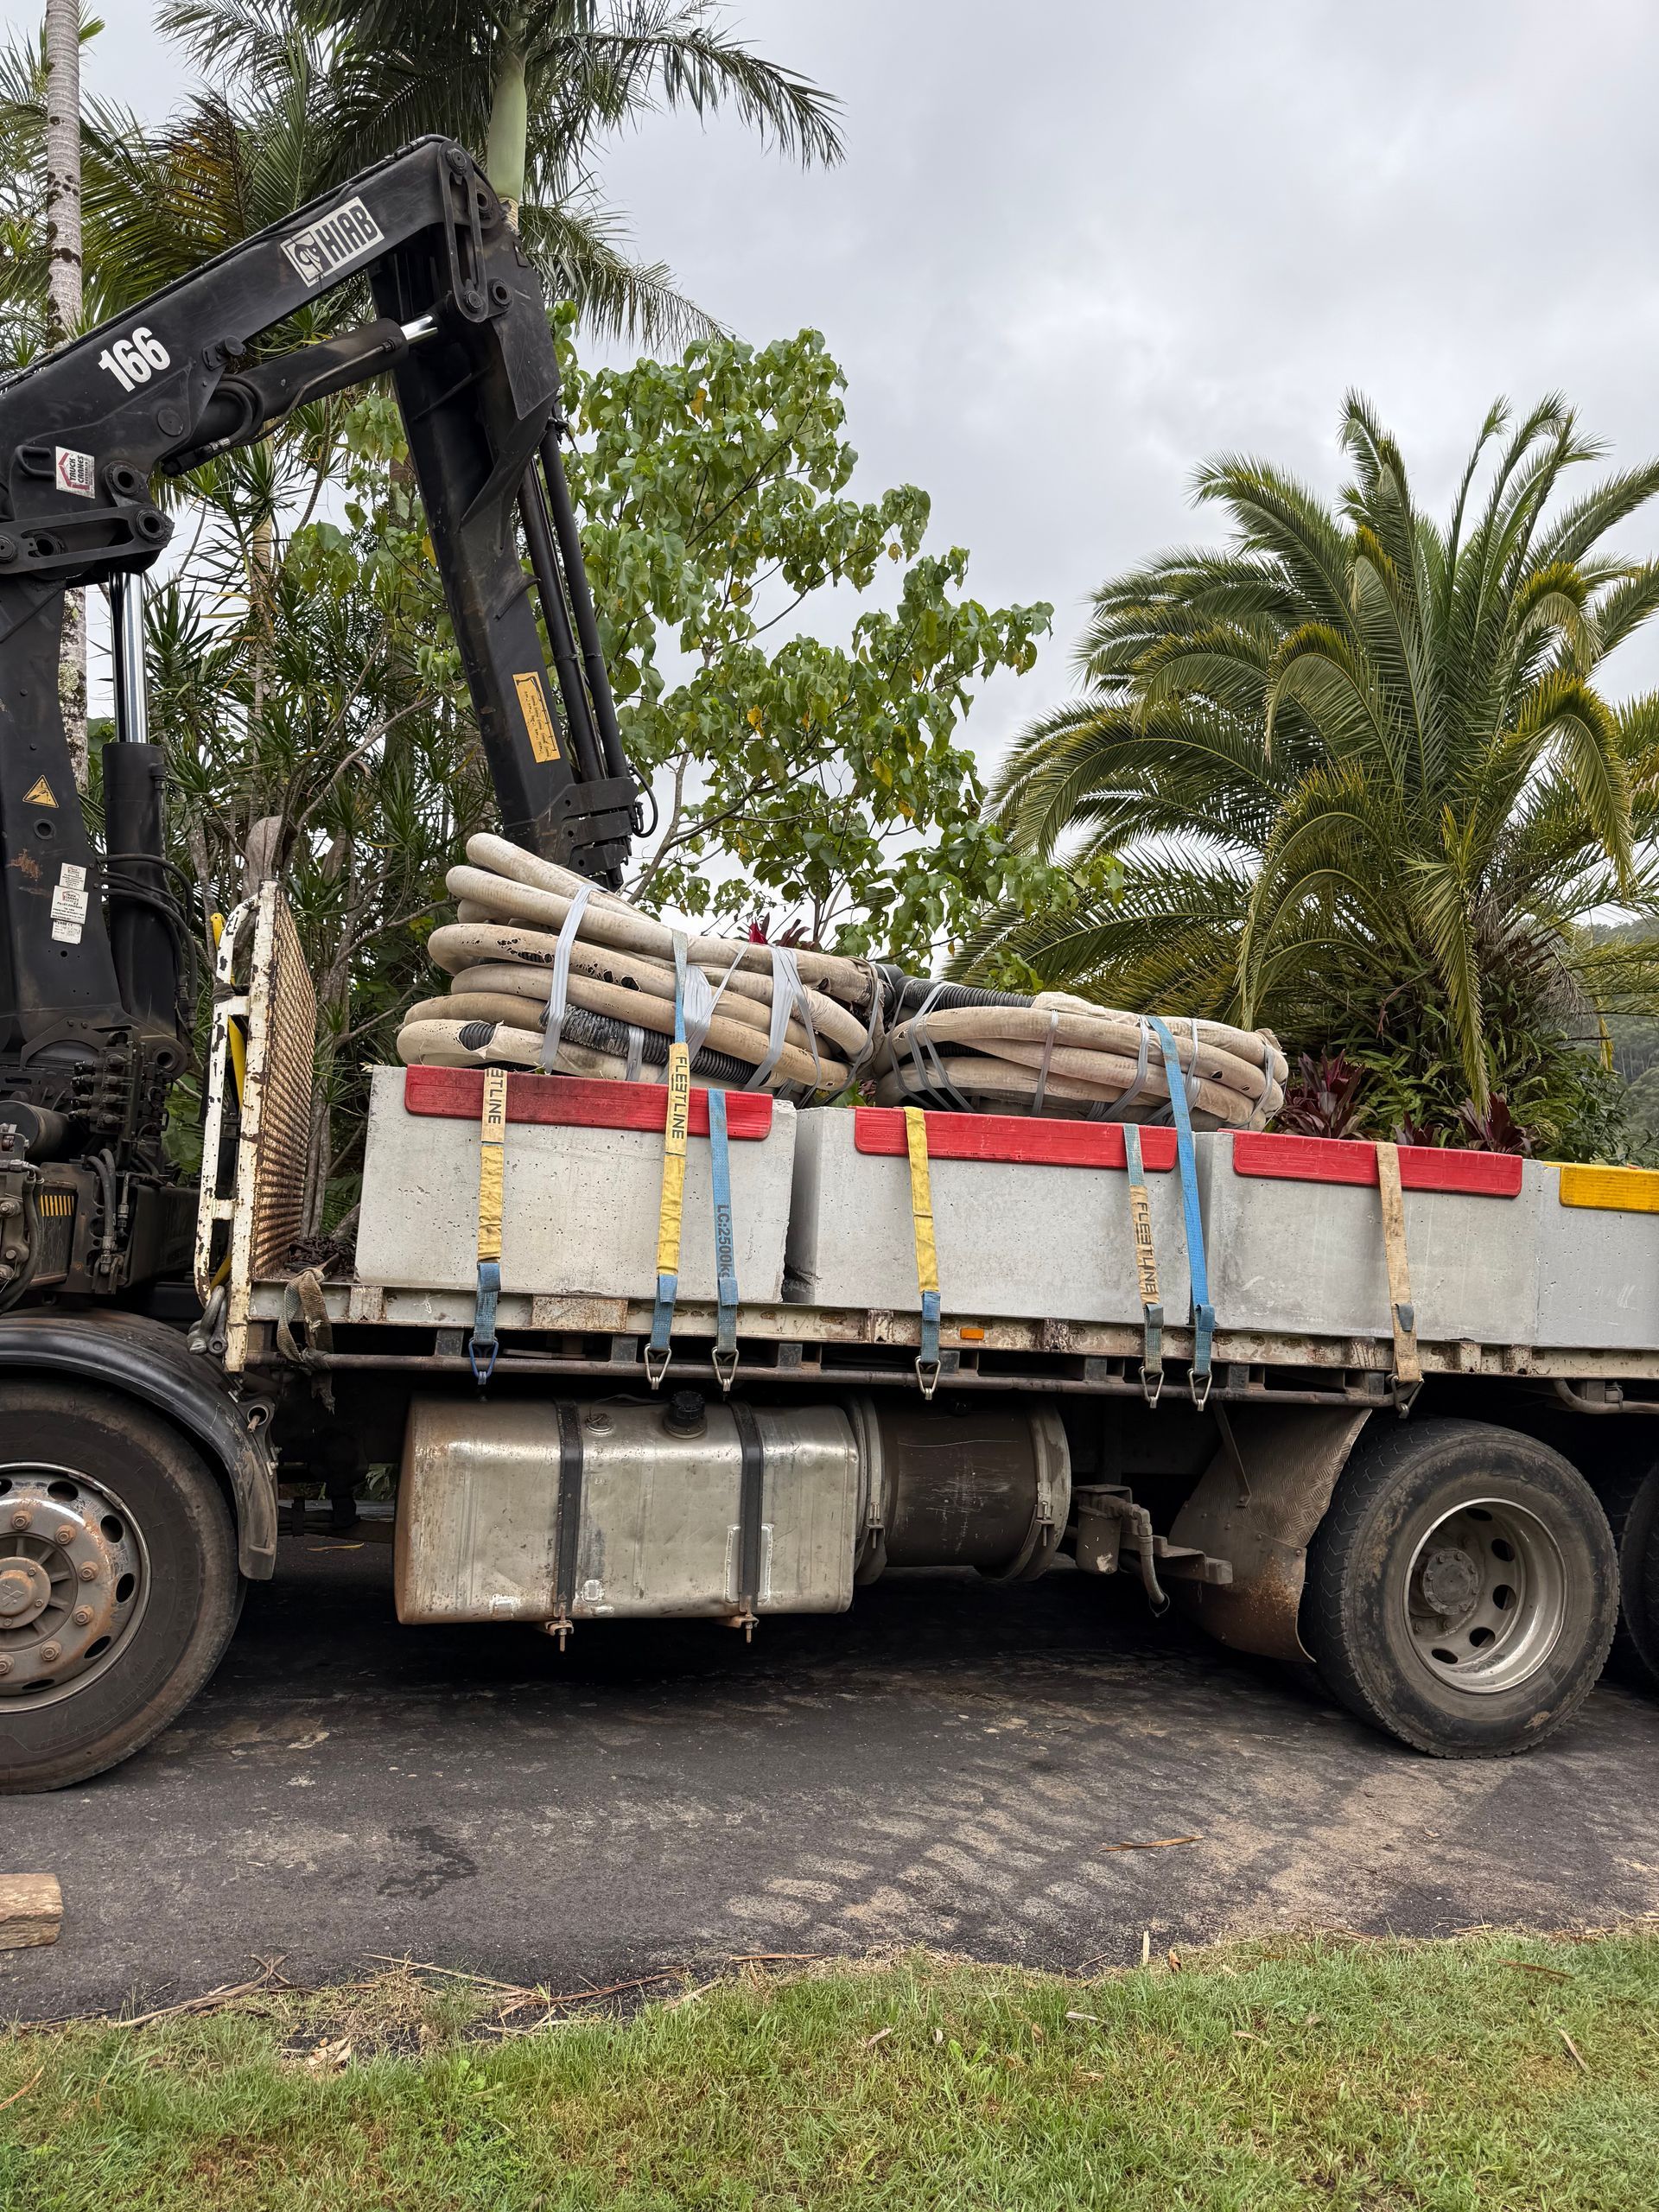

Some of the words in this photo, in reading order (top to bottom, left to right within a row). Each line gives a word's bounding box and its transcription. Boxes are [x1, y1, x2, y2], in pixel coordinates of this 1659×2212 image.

[315, 205, 378, 263] HIAB
[99, 327, 170, 391] 166
[671, 1056, 688, 1140] FLEETLINE
[1135, 1202, 1158, 1294] FLEETLINE
